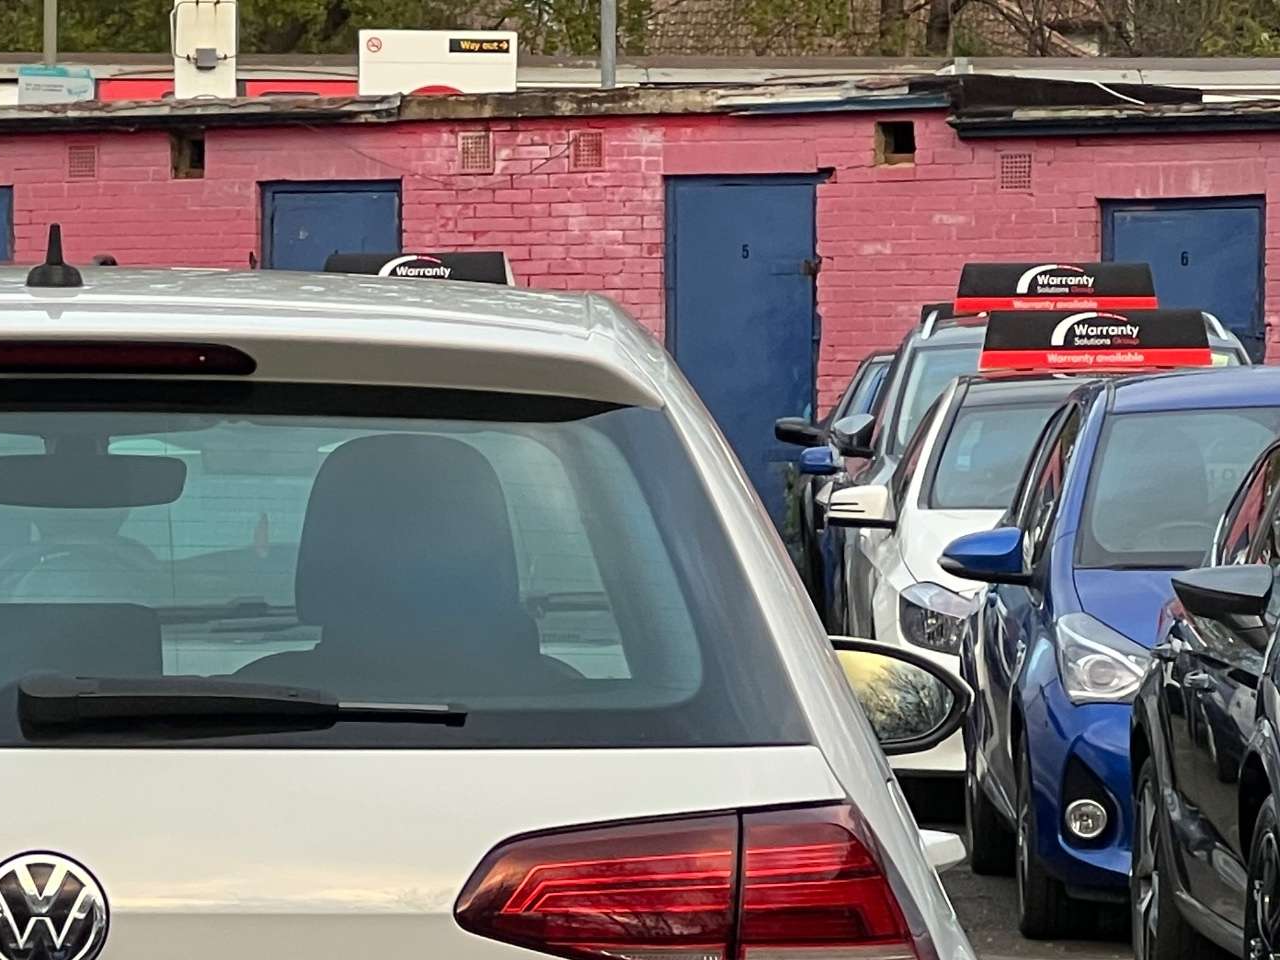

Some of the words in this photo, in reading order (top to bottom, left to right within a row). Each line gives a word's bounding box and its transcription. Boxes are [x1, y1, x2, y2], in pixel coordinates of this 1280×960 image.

[460, 41, 480, 51] Way
[482, 42, 498, 50] out
[741, 243, 750, 259] 5
[1180, 250, 1189, 266] 6
[395, 265, 451, 279] Warranty
[1036, 273, 1095, 288] Warranty
[1036, 285, 1069, 294] Solutions
[1013, 299, 1055, 310] Warranty
[1073, 323, 1140, 339] Warranty
[1073, 337, 1111, 346] Solutions
[1046, 352, 1095, 365] Warranty
[1096, 351, 1145, 362] available
